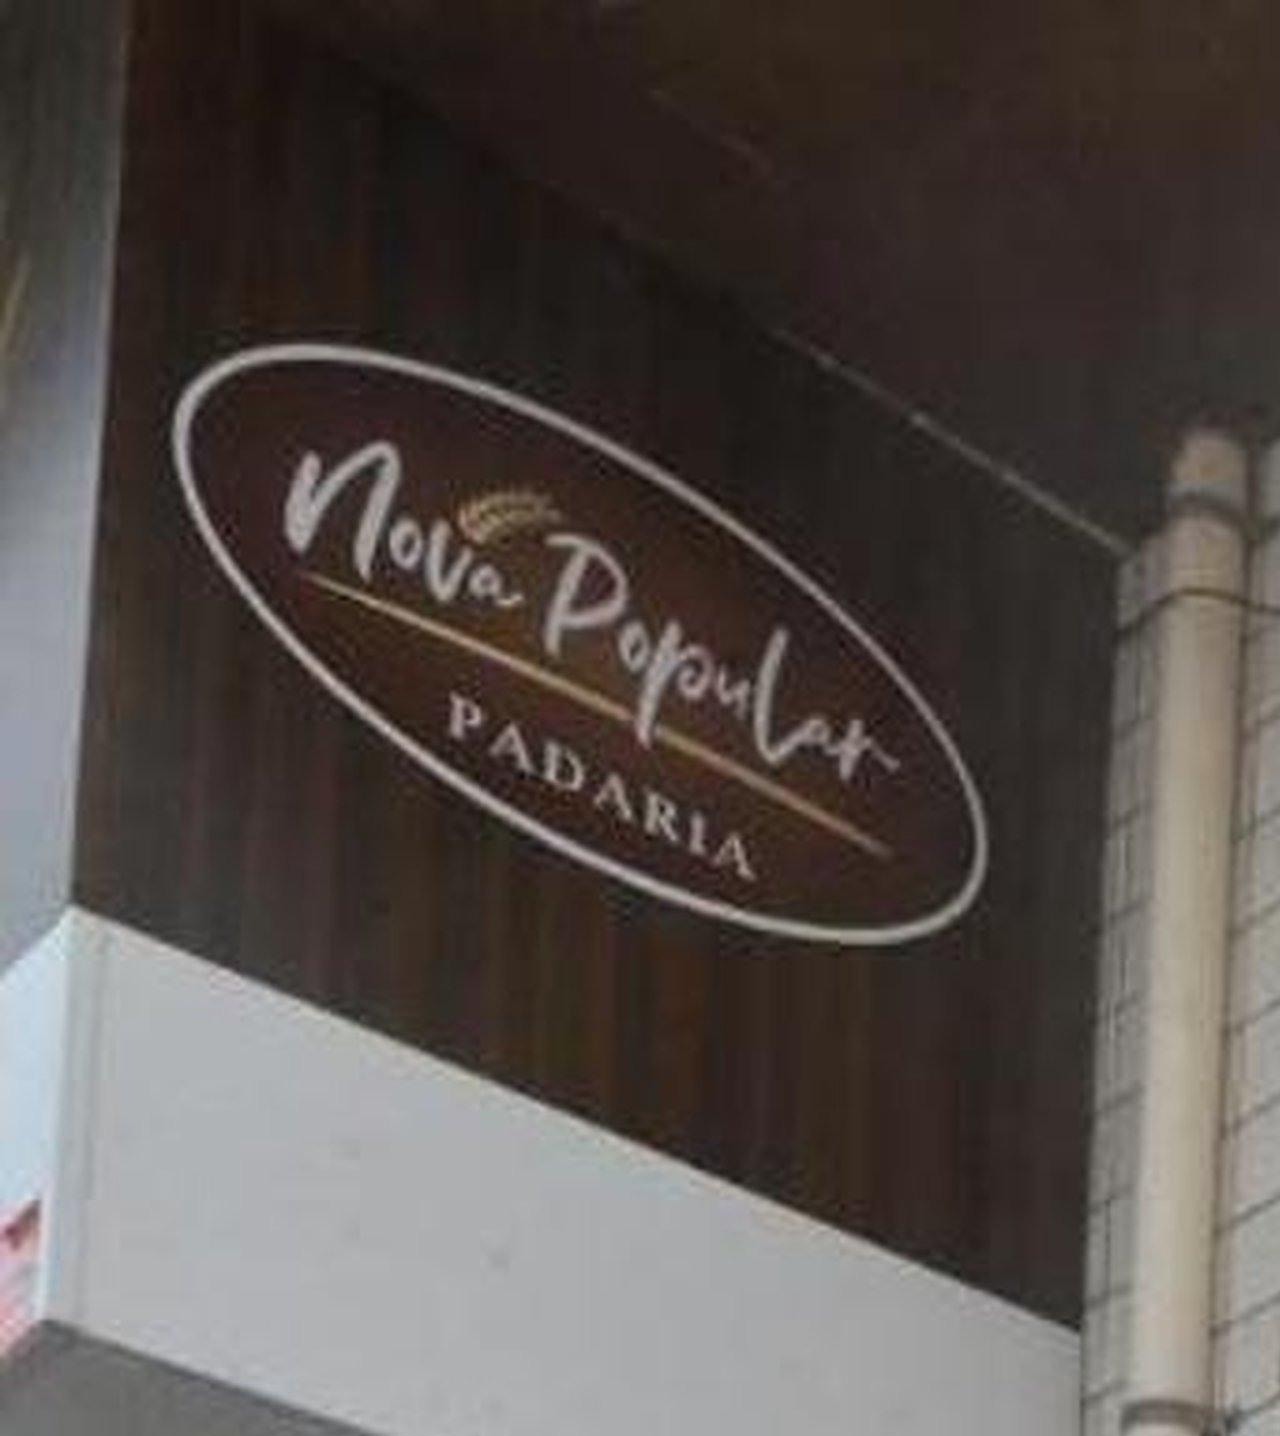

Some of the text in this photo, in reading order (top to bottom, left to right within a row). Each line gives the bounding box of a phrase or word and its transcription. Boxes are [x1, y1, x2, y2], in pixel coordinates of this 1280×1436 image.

[283, 440, 902, 777] Nova Popular
[446, 692, 758, 881] PADARIA
